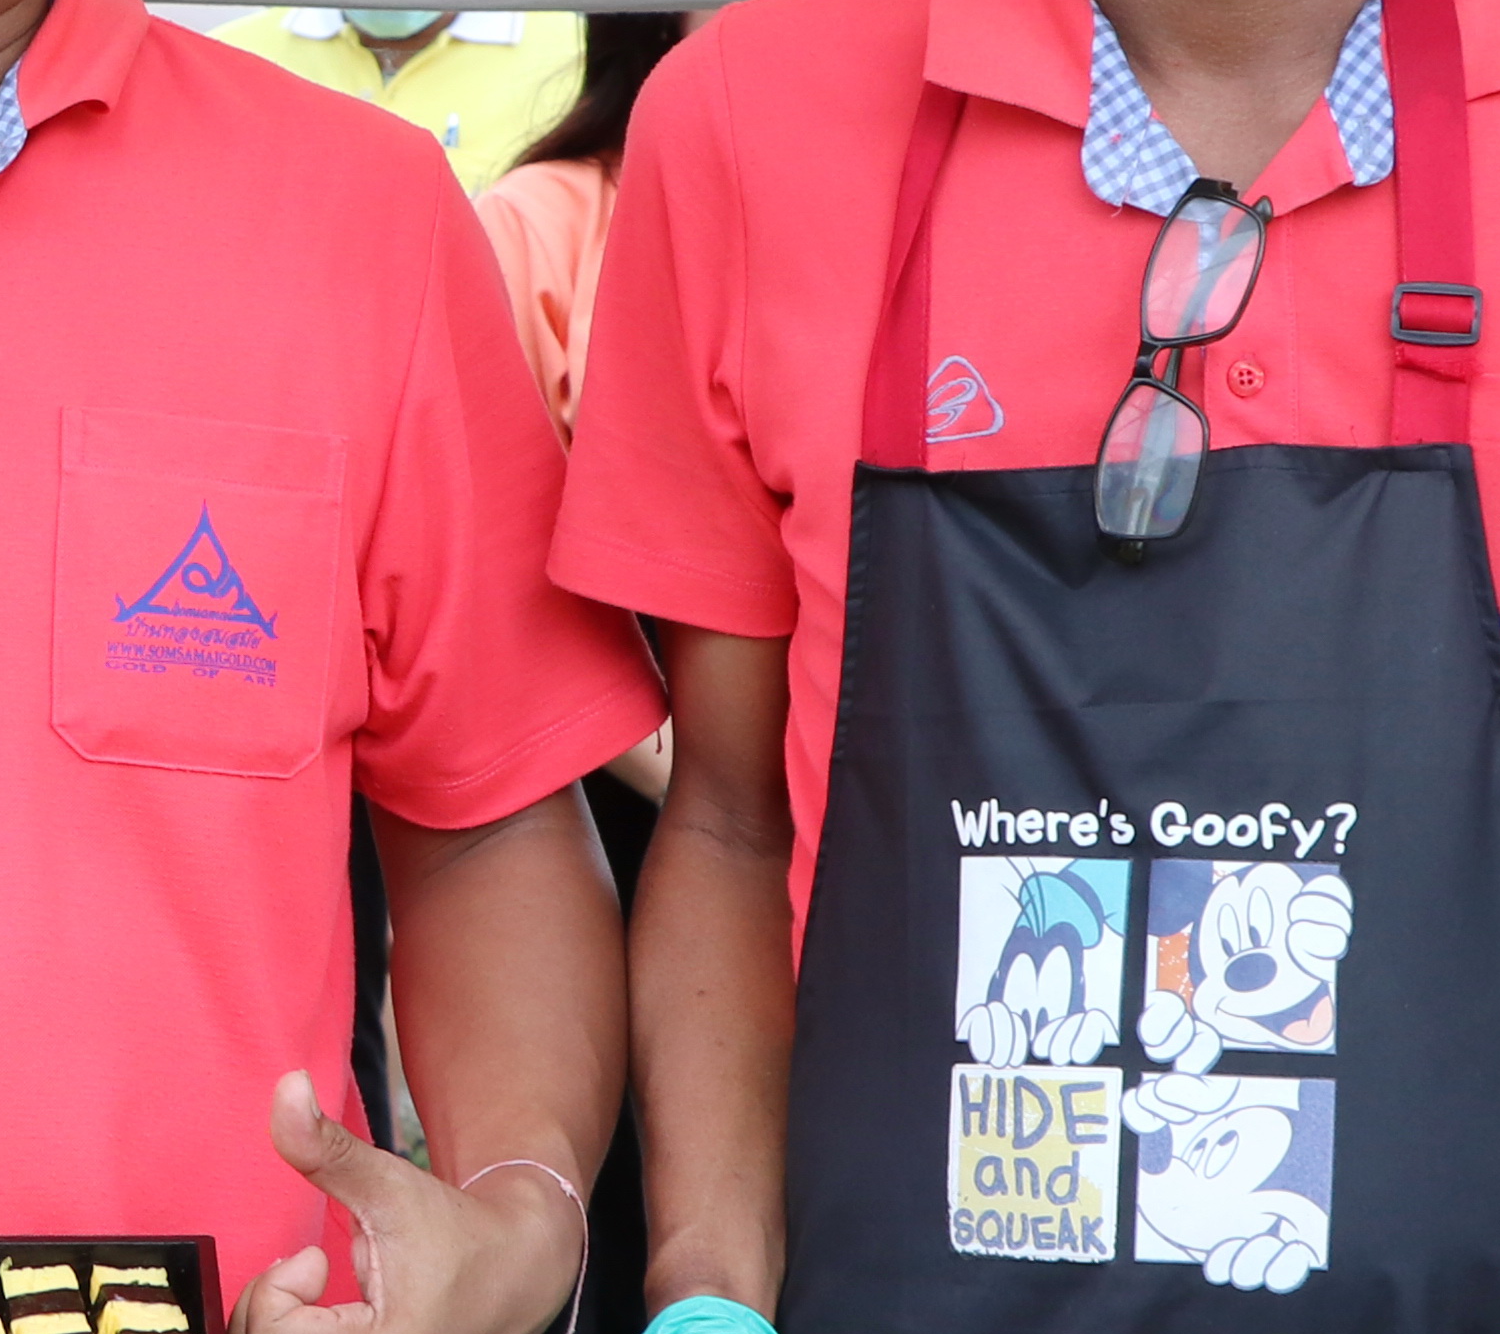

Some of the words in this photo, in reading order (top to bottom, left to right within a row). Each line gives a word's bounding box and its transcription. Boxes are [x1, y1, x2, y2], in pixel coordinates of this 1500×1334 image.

[193, 668, 220, 679] OF
[244, 675, 277, 688] ART
[951, 797, 1135, 849] Where's
[959, 1073, 1109, 1150] HIDE
[973, 1150, 1081, 1206] and
[952, 1207, 1108, 1256] SQUEAK
